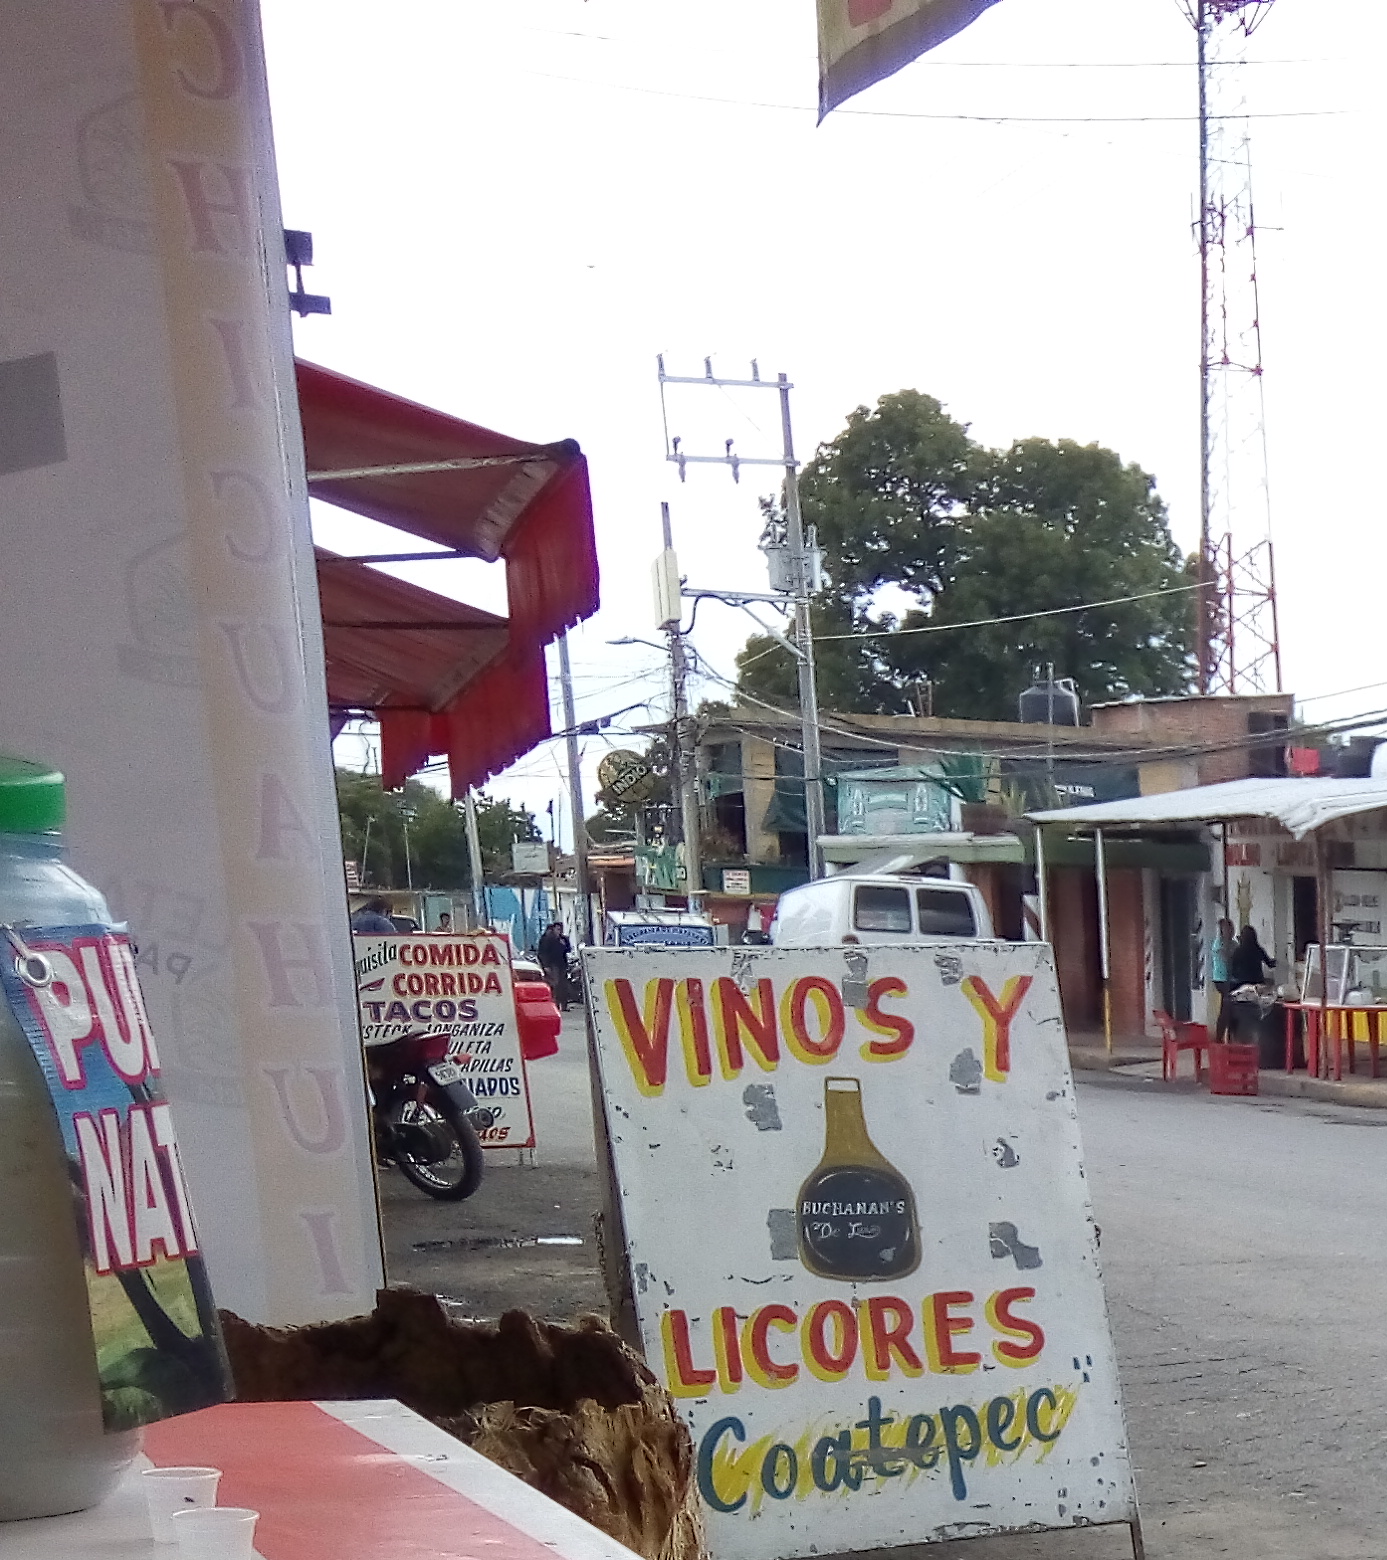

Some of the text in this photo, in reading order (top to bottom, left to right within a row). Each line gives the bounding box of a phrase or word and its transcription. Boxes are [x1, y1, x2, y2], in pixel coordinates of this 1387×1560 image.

[612, 765, 648, 795] INDIO
[399, 942, 502, 967] COMIDA
[392, 972, 503, 997] CORRIDA
[362, 999, 480, 1023] TACOS
[604, 975, 1033, 1096] VINOS Y
[801, 1200, 906, 1217] BUCHANAN'S
[660, 1286, 1046, 1399] LICORES
[699, 1386, 1063, 1514] Coatepec
